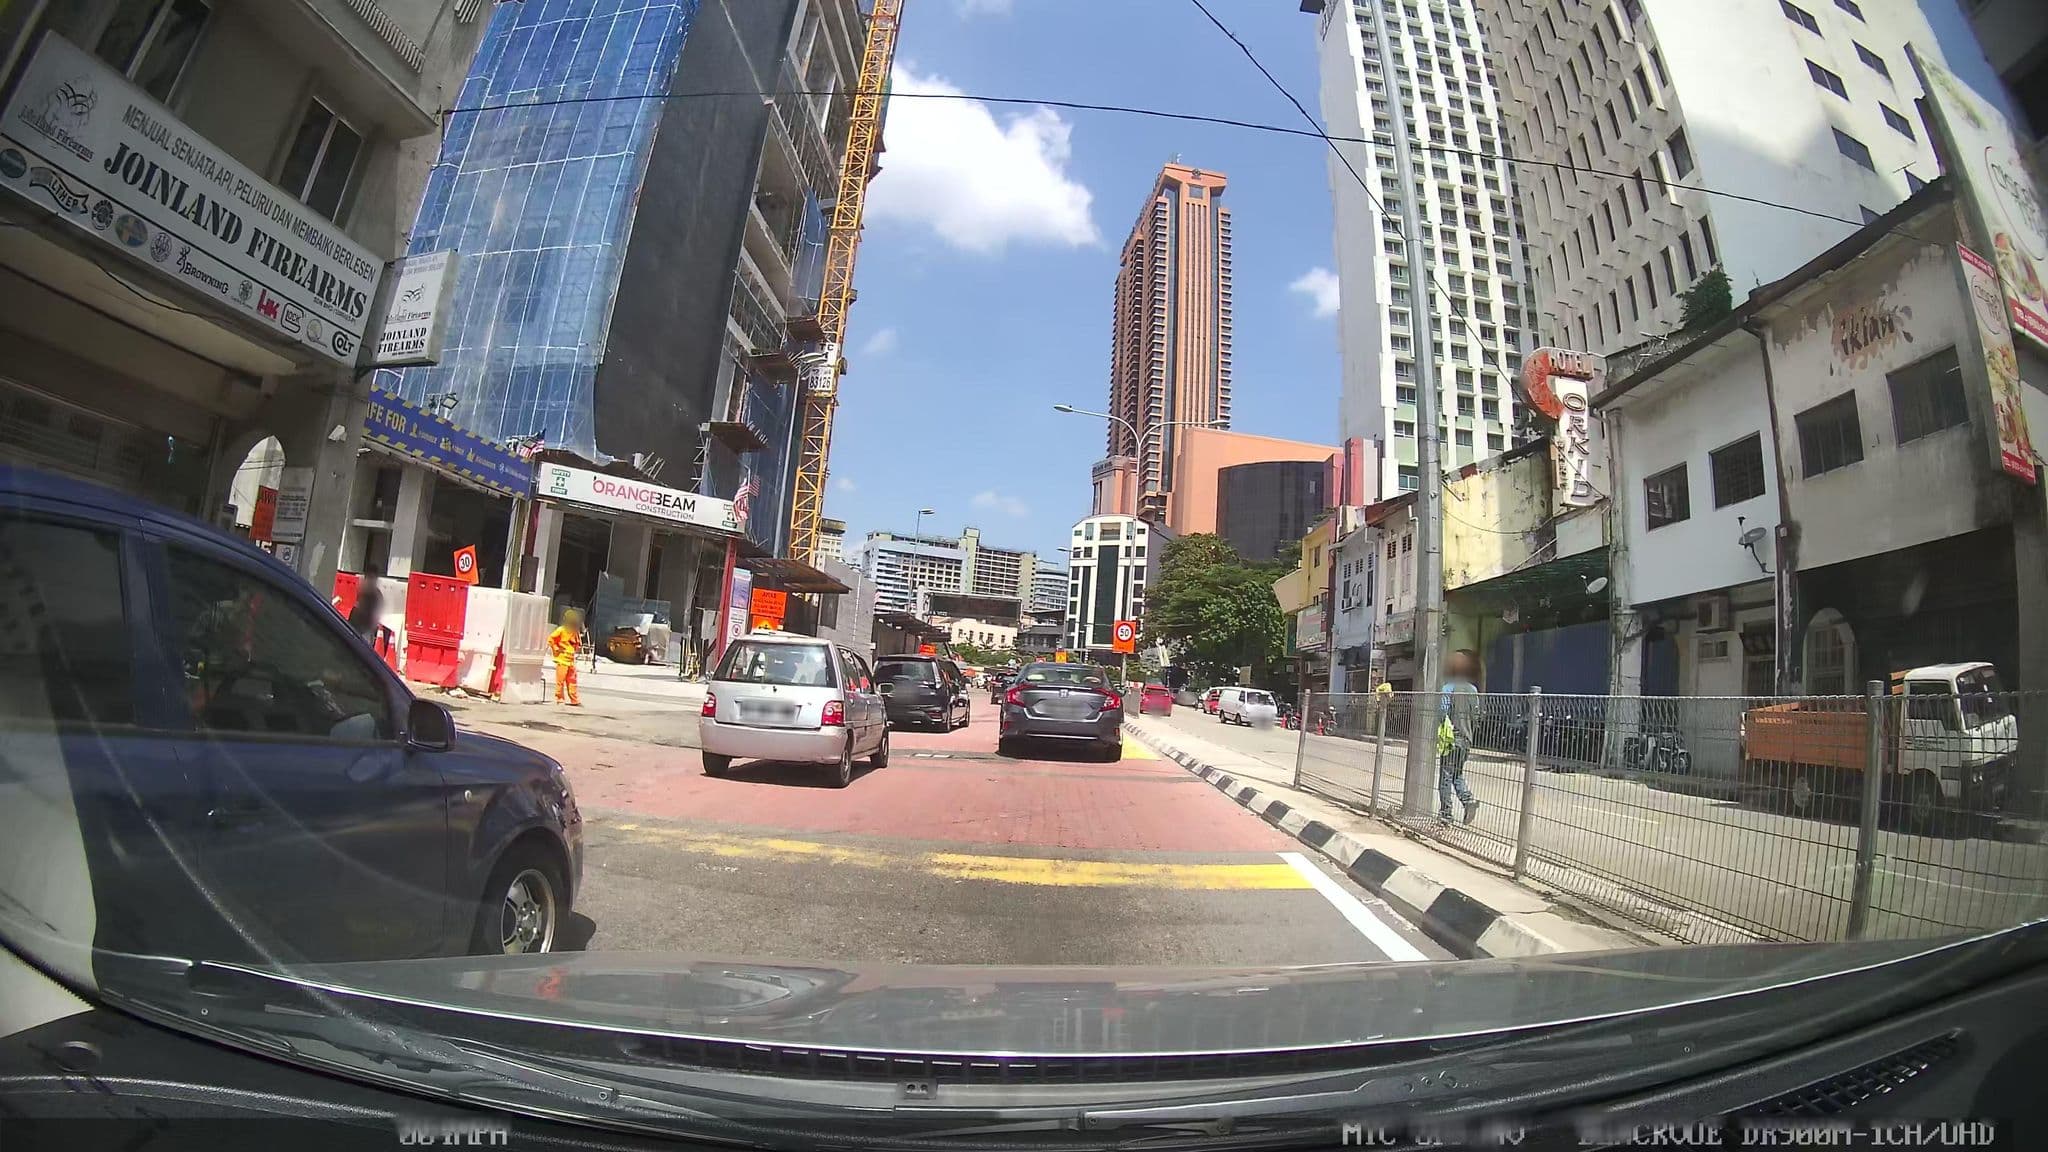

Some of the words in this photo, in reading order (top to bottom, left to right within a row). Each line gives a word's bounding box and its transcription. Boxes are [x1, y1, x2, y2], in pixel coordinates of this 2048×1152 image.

[122, 104, 169, 151] MENJUAL
[171, 137, 215, 180] SENJATA
[214, 166, 235, 196] API,
[233, 178, 273, 216] PELURU
[271, 204, 294, 230] DAN
[291, 215, 334, 257] MEMBAIKI
[332, 244, 377, 284] BERLESEN
[103, 142, 243, 245] JOINLAND
[246, 227, 368, 319] FIREARMS
[183, 262, 229, 295] BROWNING
[331, 330, 355, 357] COLT
[378, 339, 426, 354] FIREARMS
[381, 327, 427, 342] JOINLAND
[385, 409, 407, 434] FOR
[1562, 392, 1590, 498] ORKID
[635, 503, 695, 521] CONSTRUCTION
[460, 556, 471, 569] 30
[1119, 628, 1130, 637] 50
